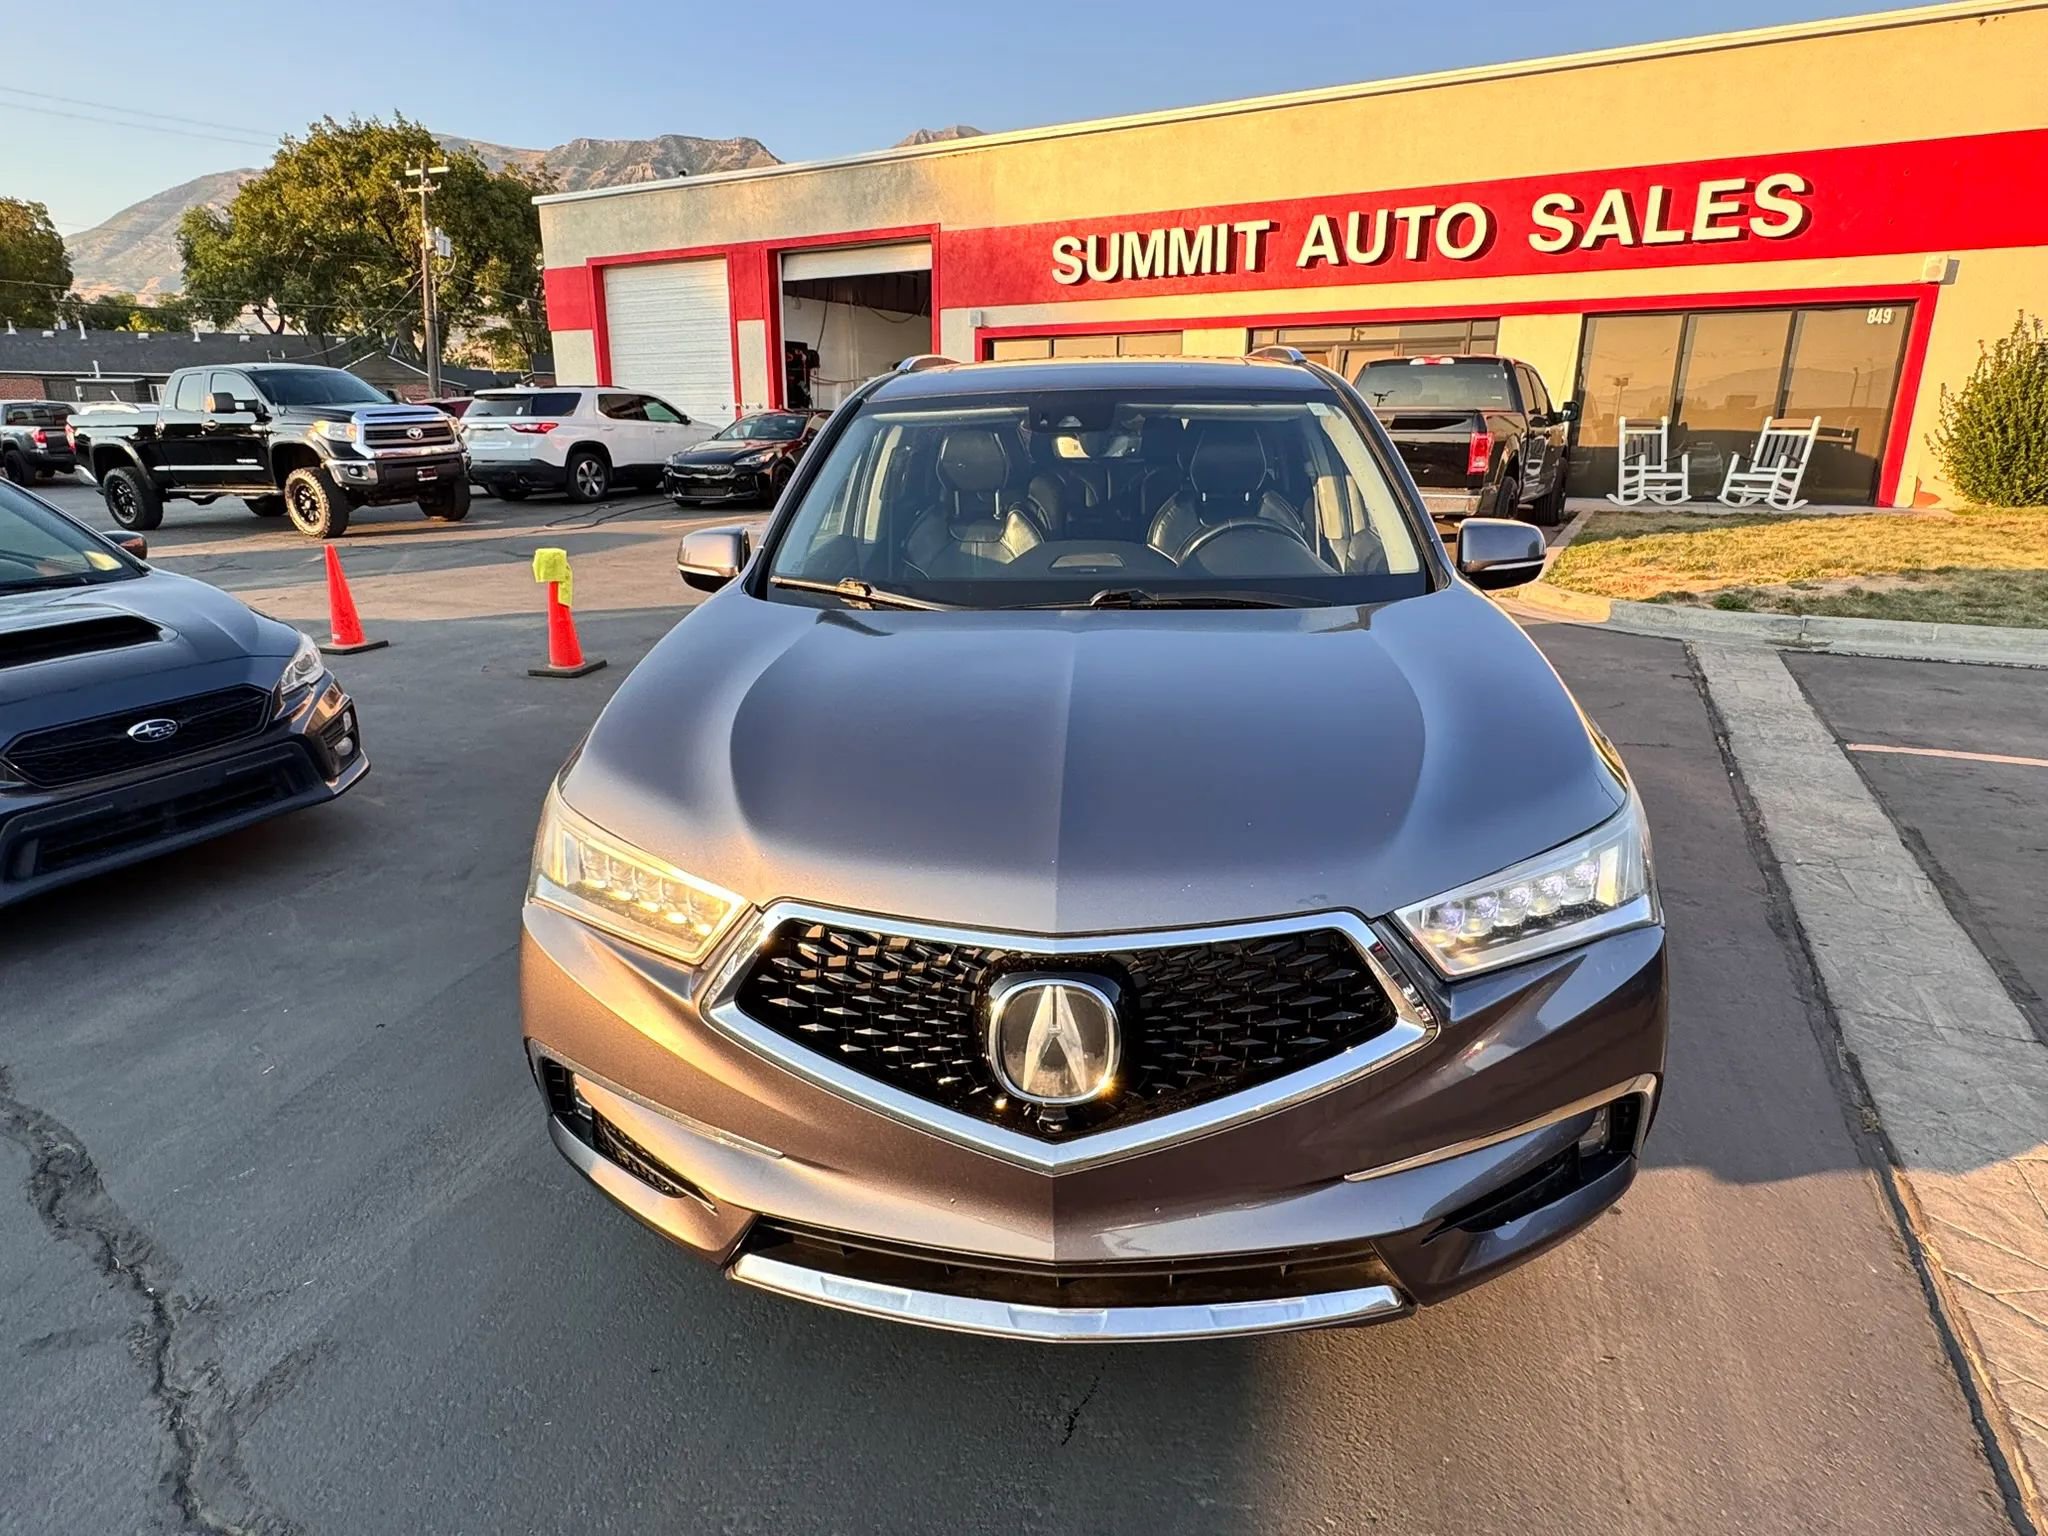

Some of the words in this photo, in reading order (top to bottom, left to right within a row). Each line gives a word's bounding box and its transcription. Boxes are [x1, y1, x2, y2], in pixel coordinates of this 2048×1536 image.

[1051, 219, 1272, 285] SUMMIT
[1296, 201, 1489, 268] AUTO
[1528, 172, 1808, 254] SALES
[1866, 307, 1893, 325] 849
